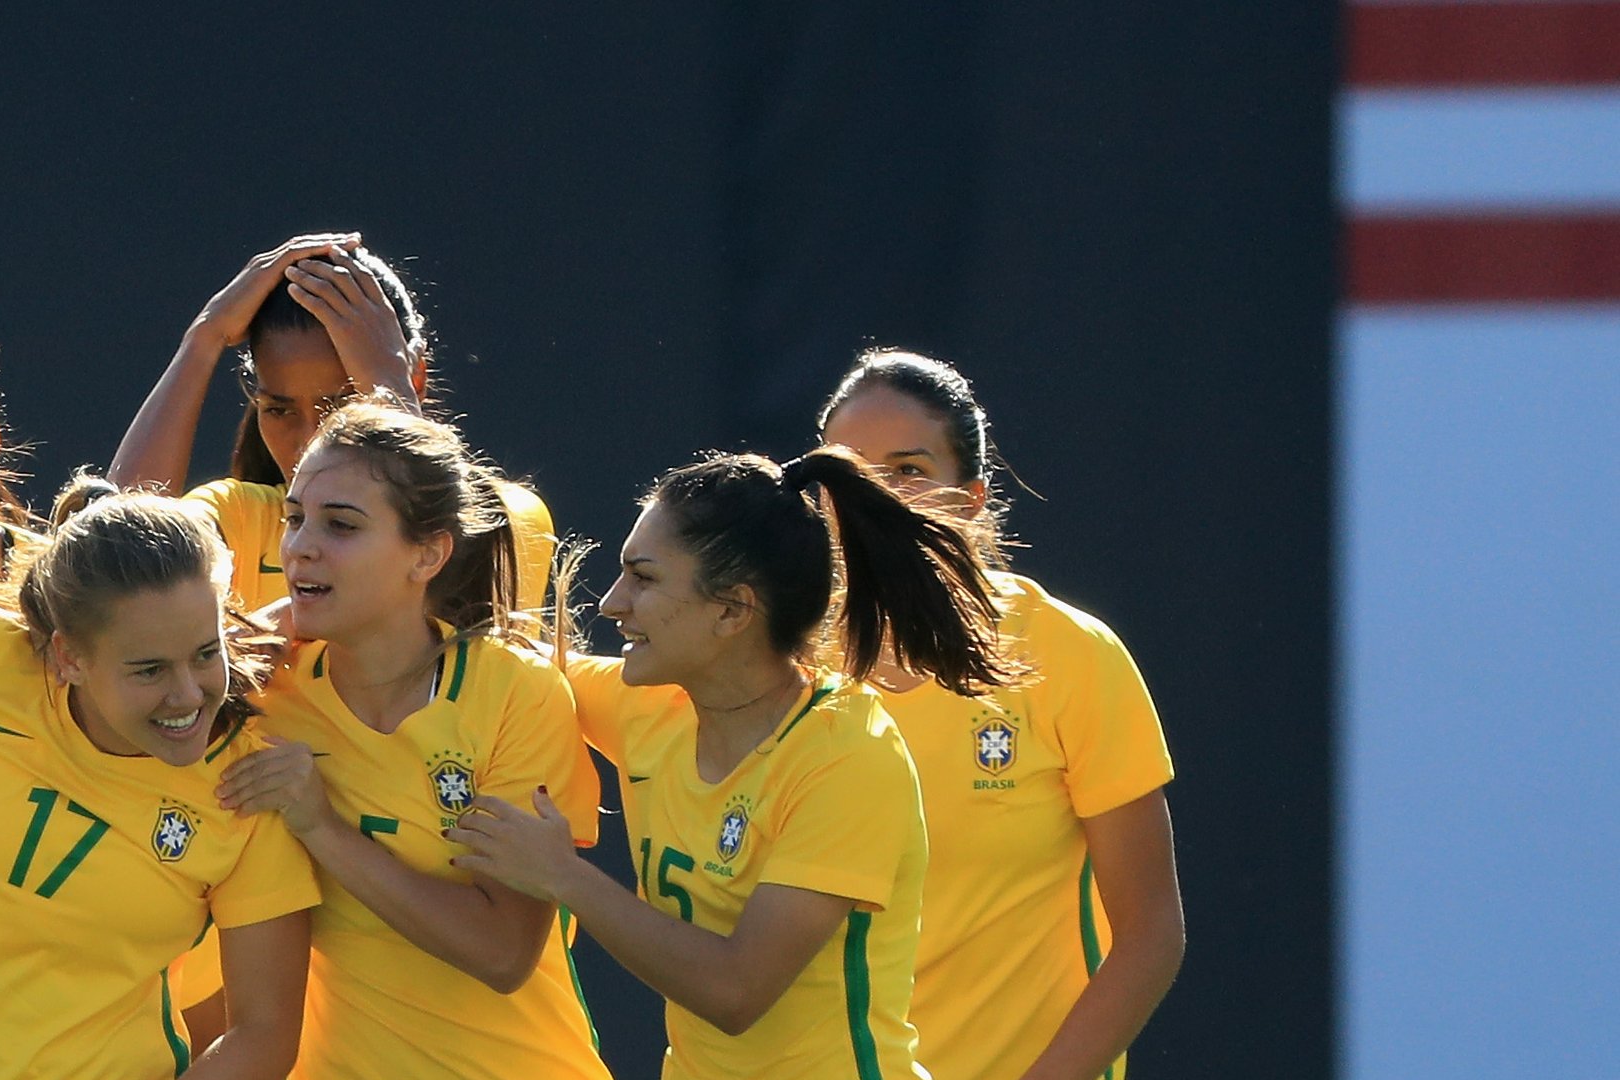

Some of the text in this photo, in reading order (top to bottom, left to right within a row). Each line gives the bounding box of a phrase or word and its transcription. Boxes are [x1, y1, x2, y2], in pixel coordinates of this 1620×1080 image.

[973, 779, 1016, 790] BRASIL
[8, 787, 110, 899] 17
[640, 837, 696, 923] 15
